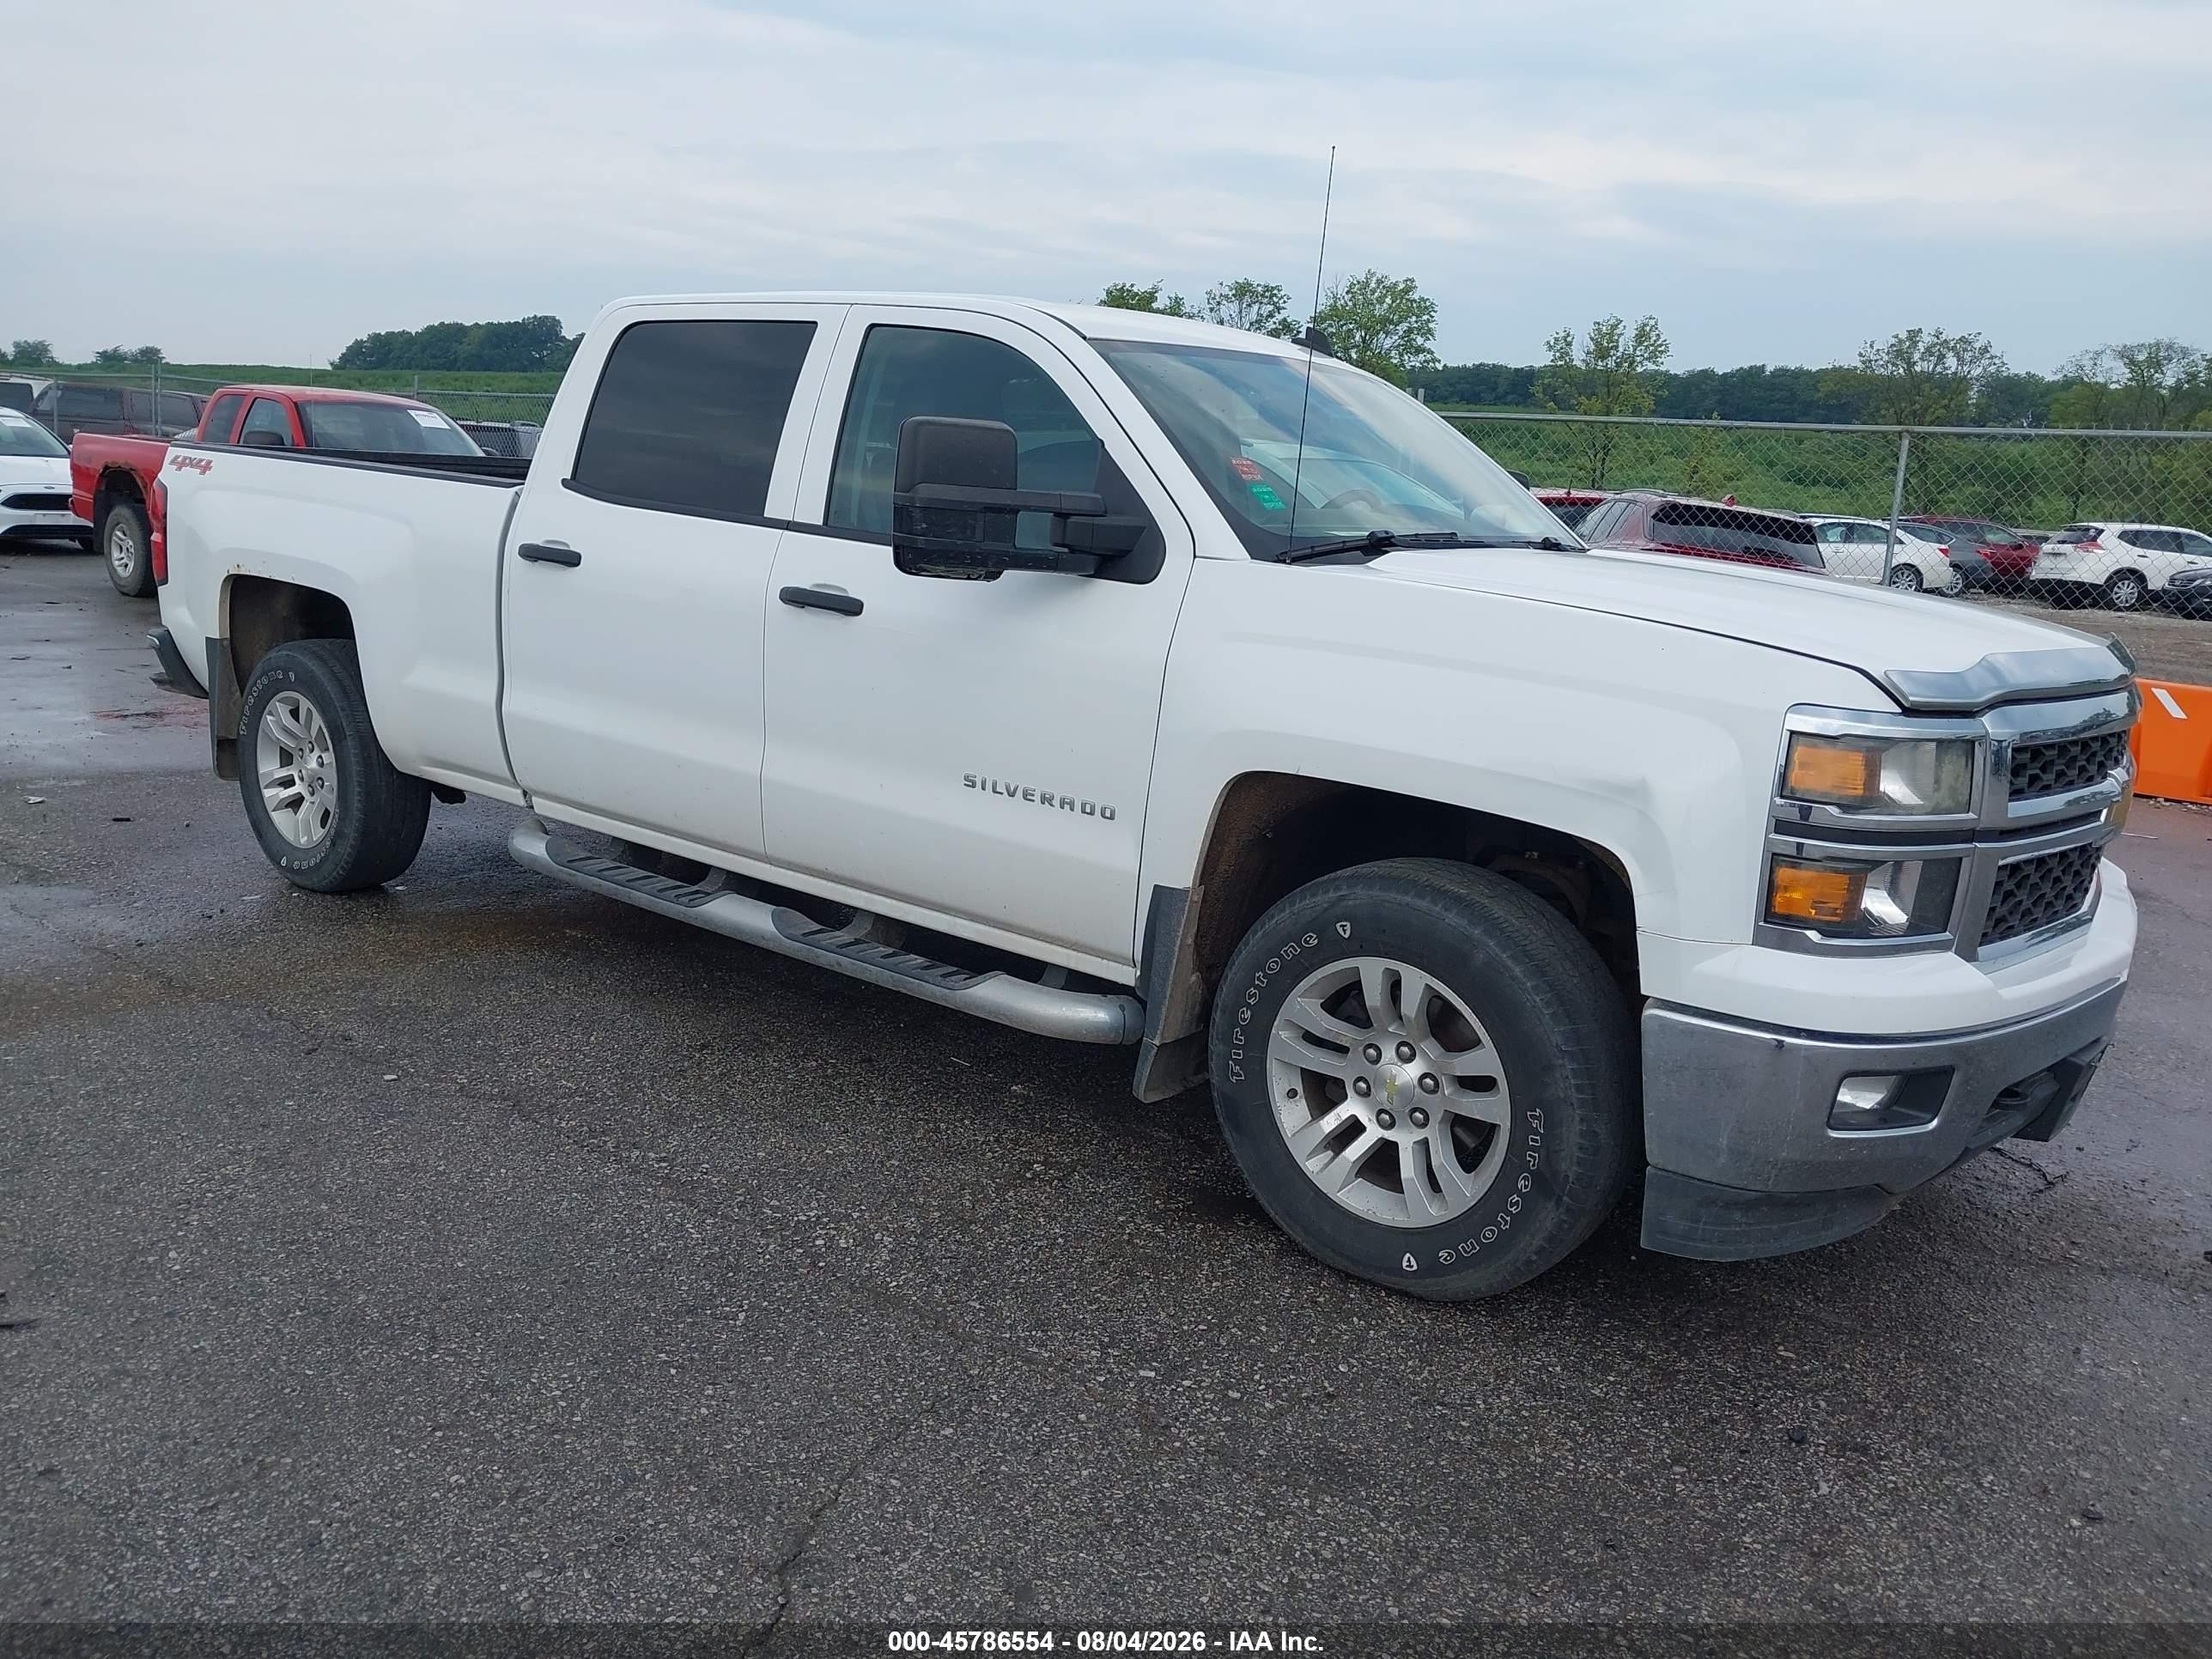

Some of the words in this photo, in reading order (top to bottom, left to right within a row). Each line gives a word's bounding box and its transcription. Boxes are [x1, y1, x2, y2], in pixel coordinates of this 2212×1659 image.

[963, 772, 1117, 821] SILVERADO
[1229, 932, 1319, 1085] Firestone
[1438, 1108, 1545, 1266] Firestone
